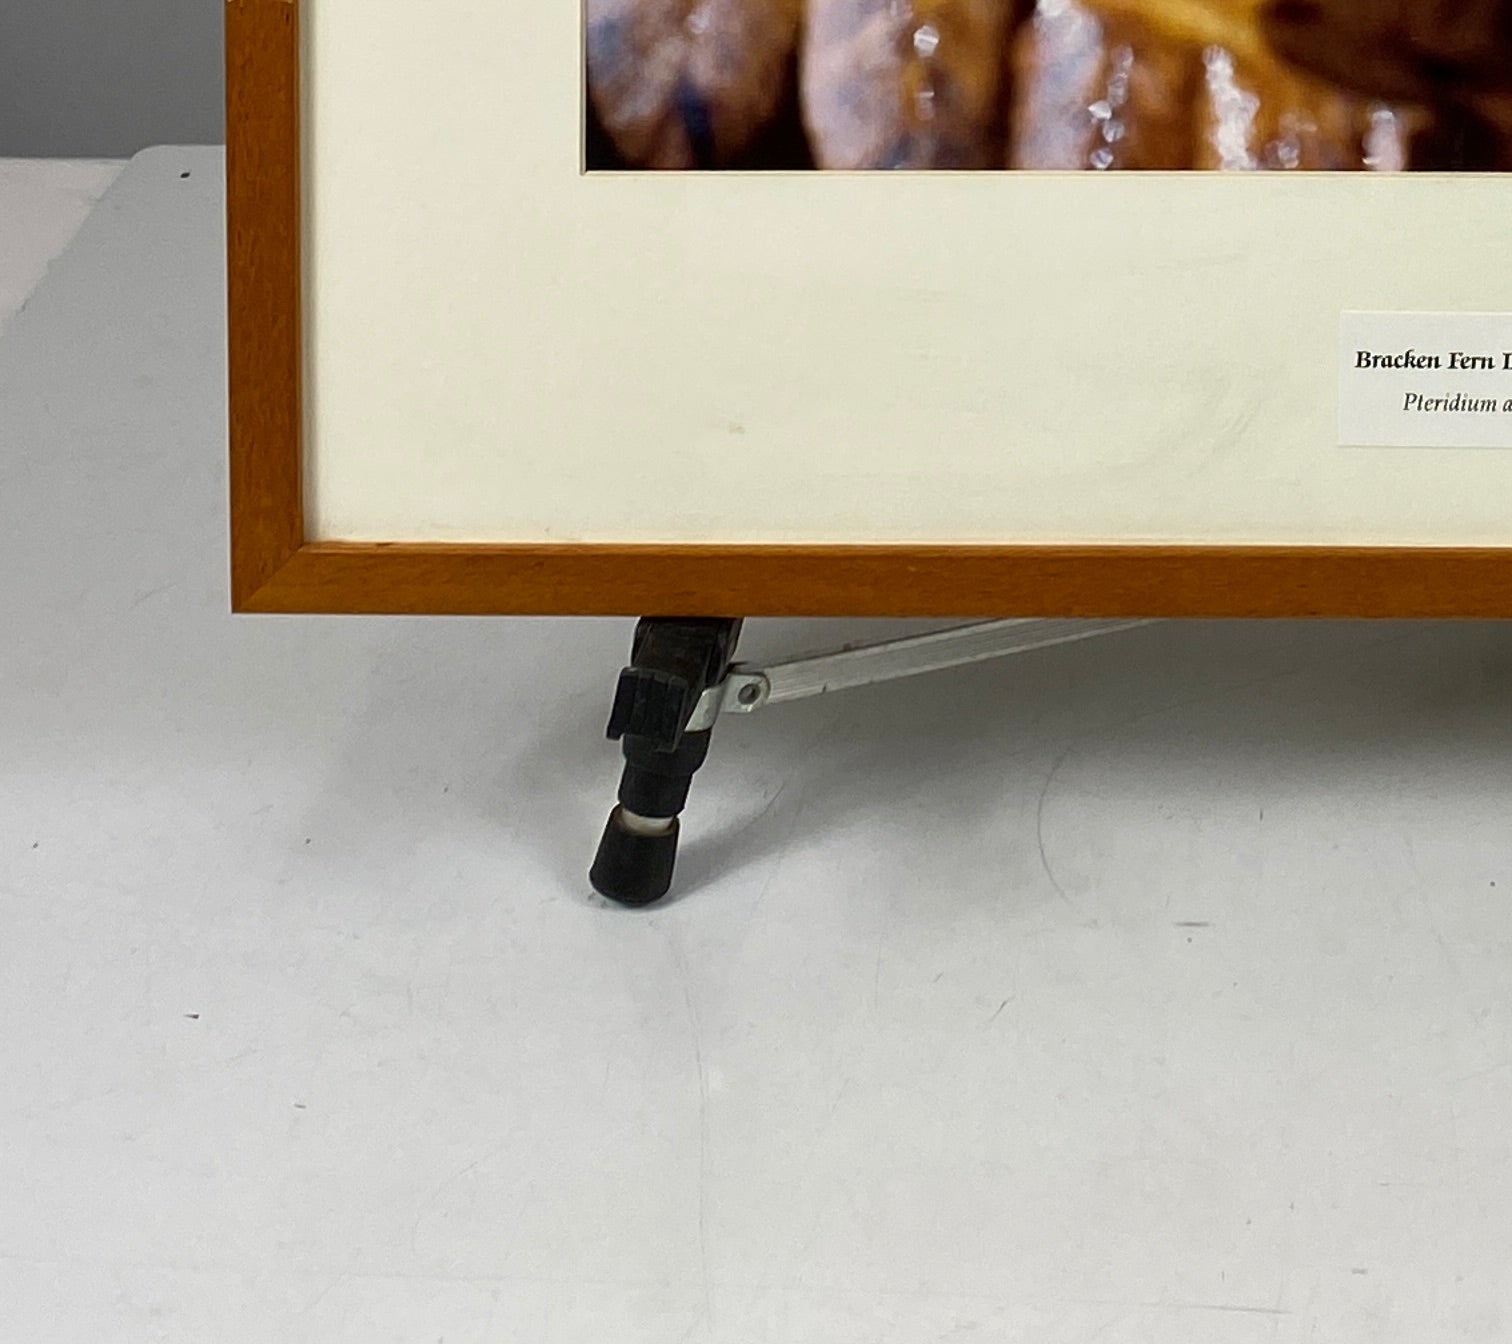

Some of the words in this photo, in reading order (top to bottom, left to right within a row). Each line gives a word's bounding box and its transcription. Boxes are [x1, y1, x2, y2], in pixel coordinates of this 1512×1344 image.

[1354, 349, 1442, 370] Bracken
[1447, 351, 1496, 370] Fern
[1402, 392, 1497, 413] Pteridium
